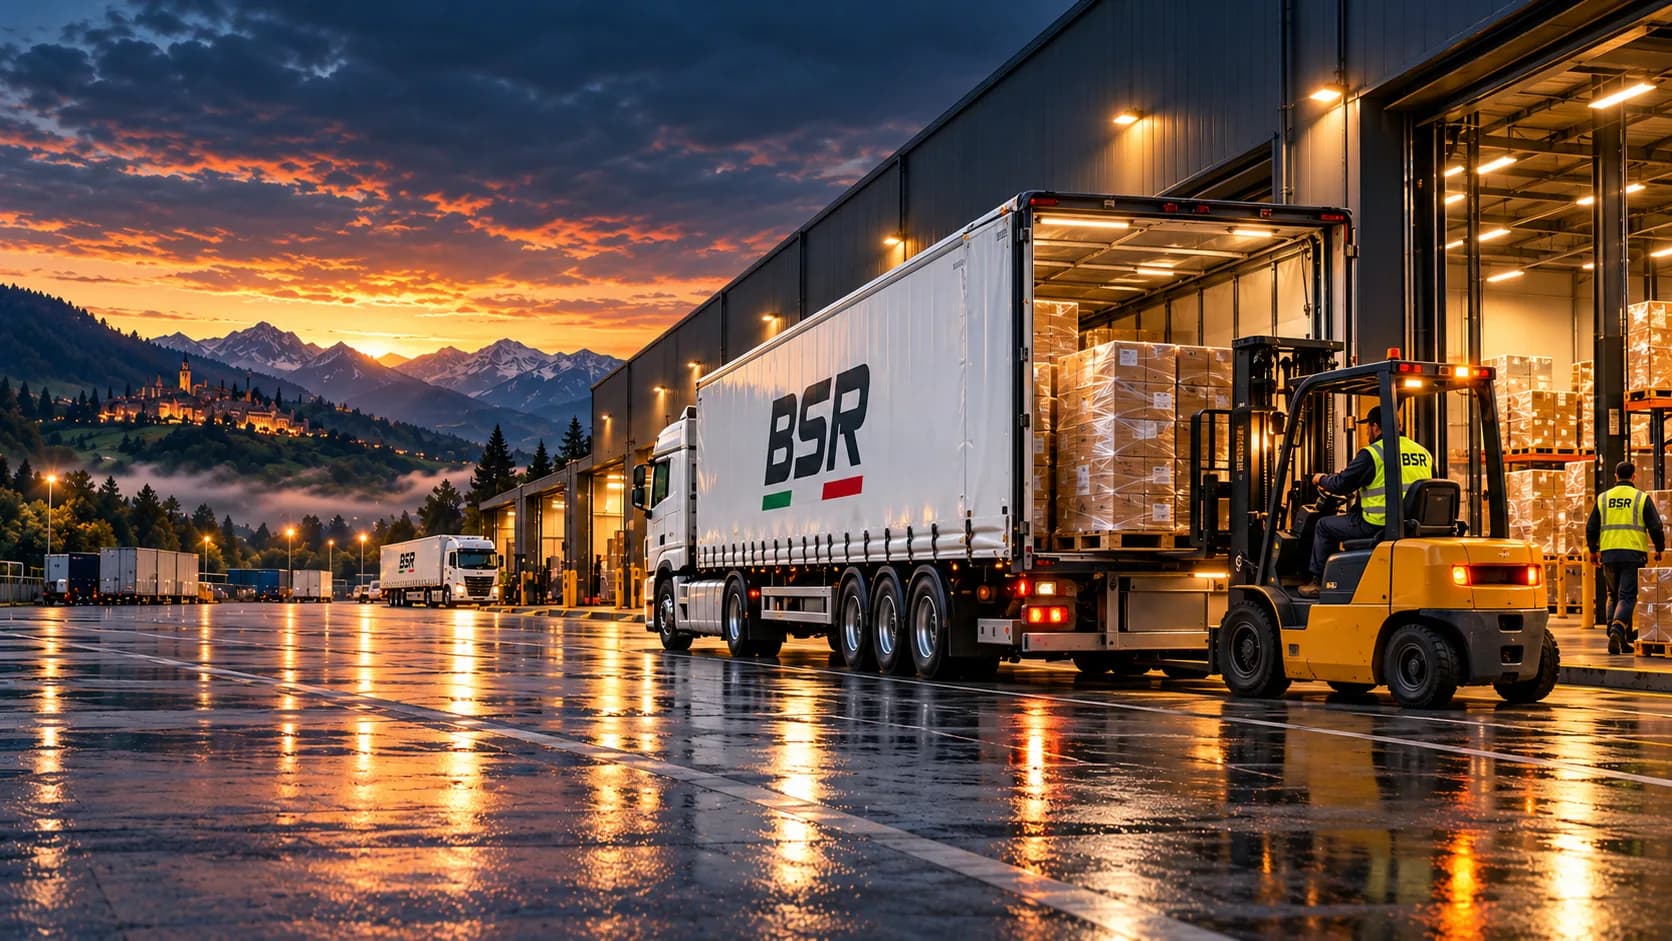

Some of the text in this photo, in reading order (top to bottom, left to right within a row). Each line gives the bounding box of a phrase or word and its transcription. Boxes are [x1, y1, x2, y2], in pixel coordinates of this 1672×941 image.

[764, 363, 870, 486] BSR
[1401, 453, 1427, 467] BSR
[1609, 498, 1632, 508] BSR
[399, 552, 415, 569] BSR
